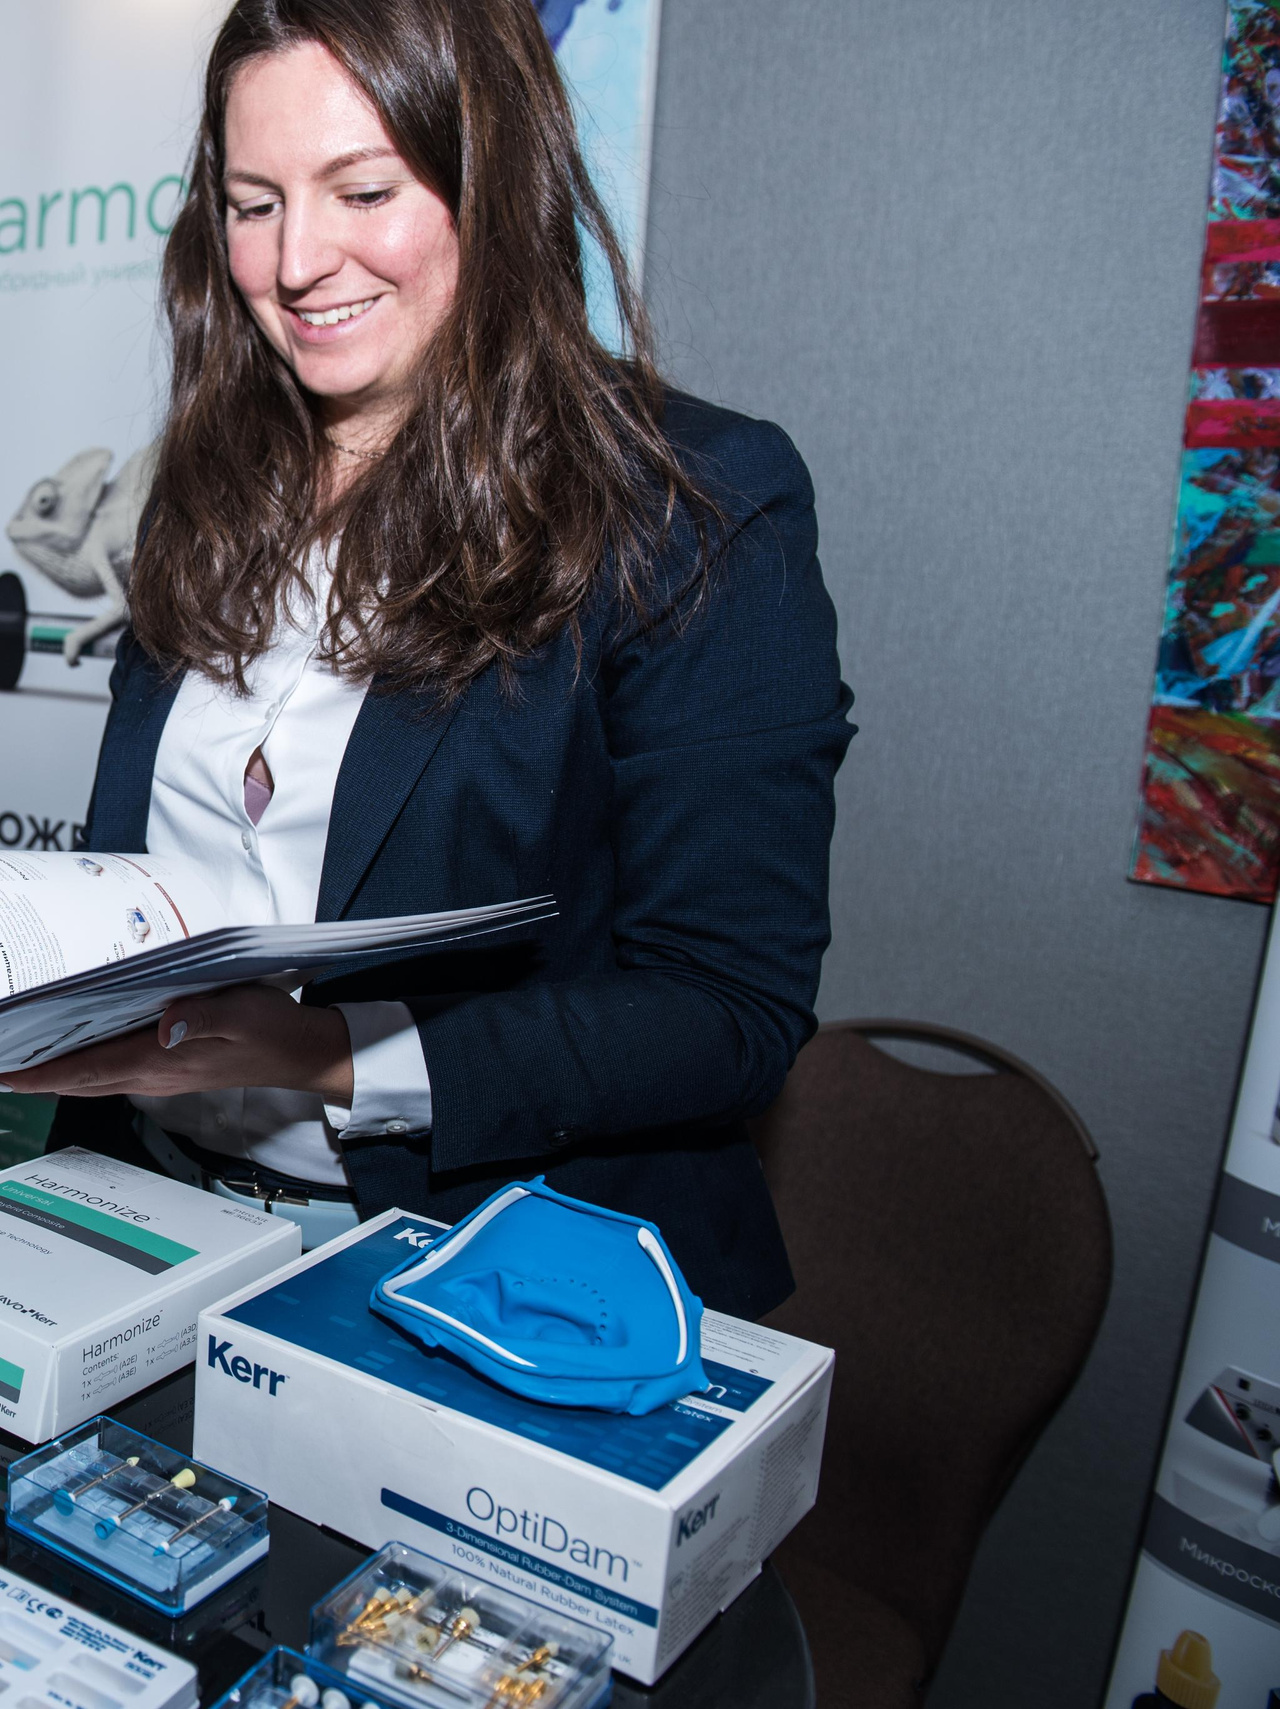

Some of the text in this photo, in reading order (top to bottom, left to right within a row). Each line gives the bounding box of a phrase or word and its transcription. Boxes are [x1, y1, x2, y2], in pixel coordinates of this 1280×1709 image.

[1, 1185, 55, 1206] Universal
[24, 1174, 151, 1223] Harmonize
[22, 1209, 65, 1229] Composite
[6, 1233, 53, 1255] Technology
[31, 1312, 58, 1327] Kerr
[82, 1314, 161, 1363] Harmonize
[82, 1353, 119, 1376] Contents:
[119, 1354, 138, 1371] (A2E)
[207, 1334, 286, 1398] Kerr
[118, 1367, 137, 1384] (A3E)
[0, 1405, 17, 1419] Kerr
[674, 1406, 714, 1423] Latex
[676, 1492, 721, 1548] Kerr
[446, 1521, 638, 1617] 3-Dimensional Rubber-Dam System
[450, 1543, 635, 1638] 100% Natural Rubber Latex
[133, 1650, 168, 1671] Kerr
